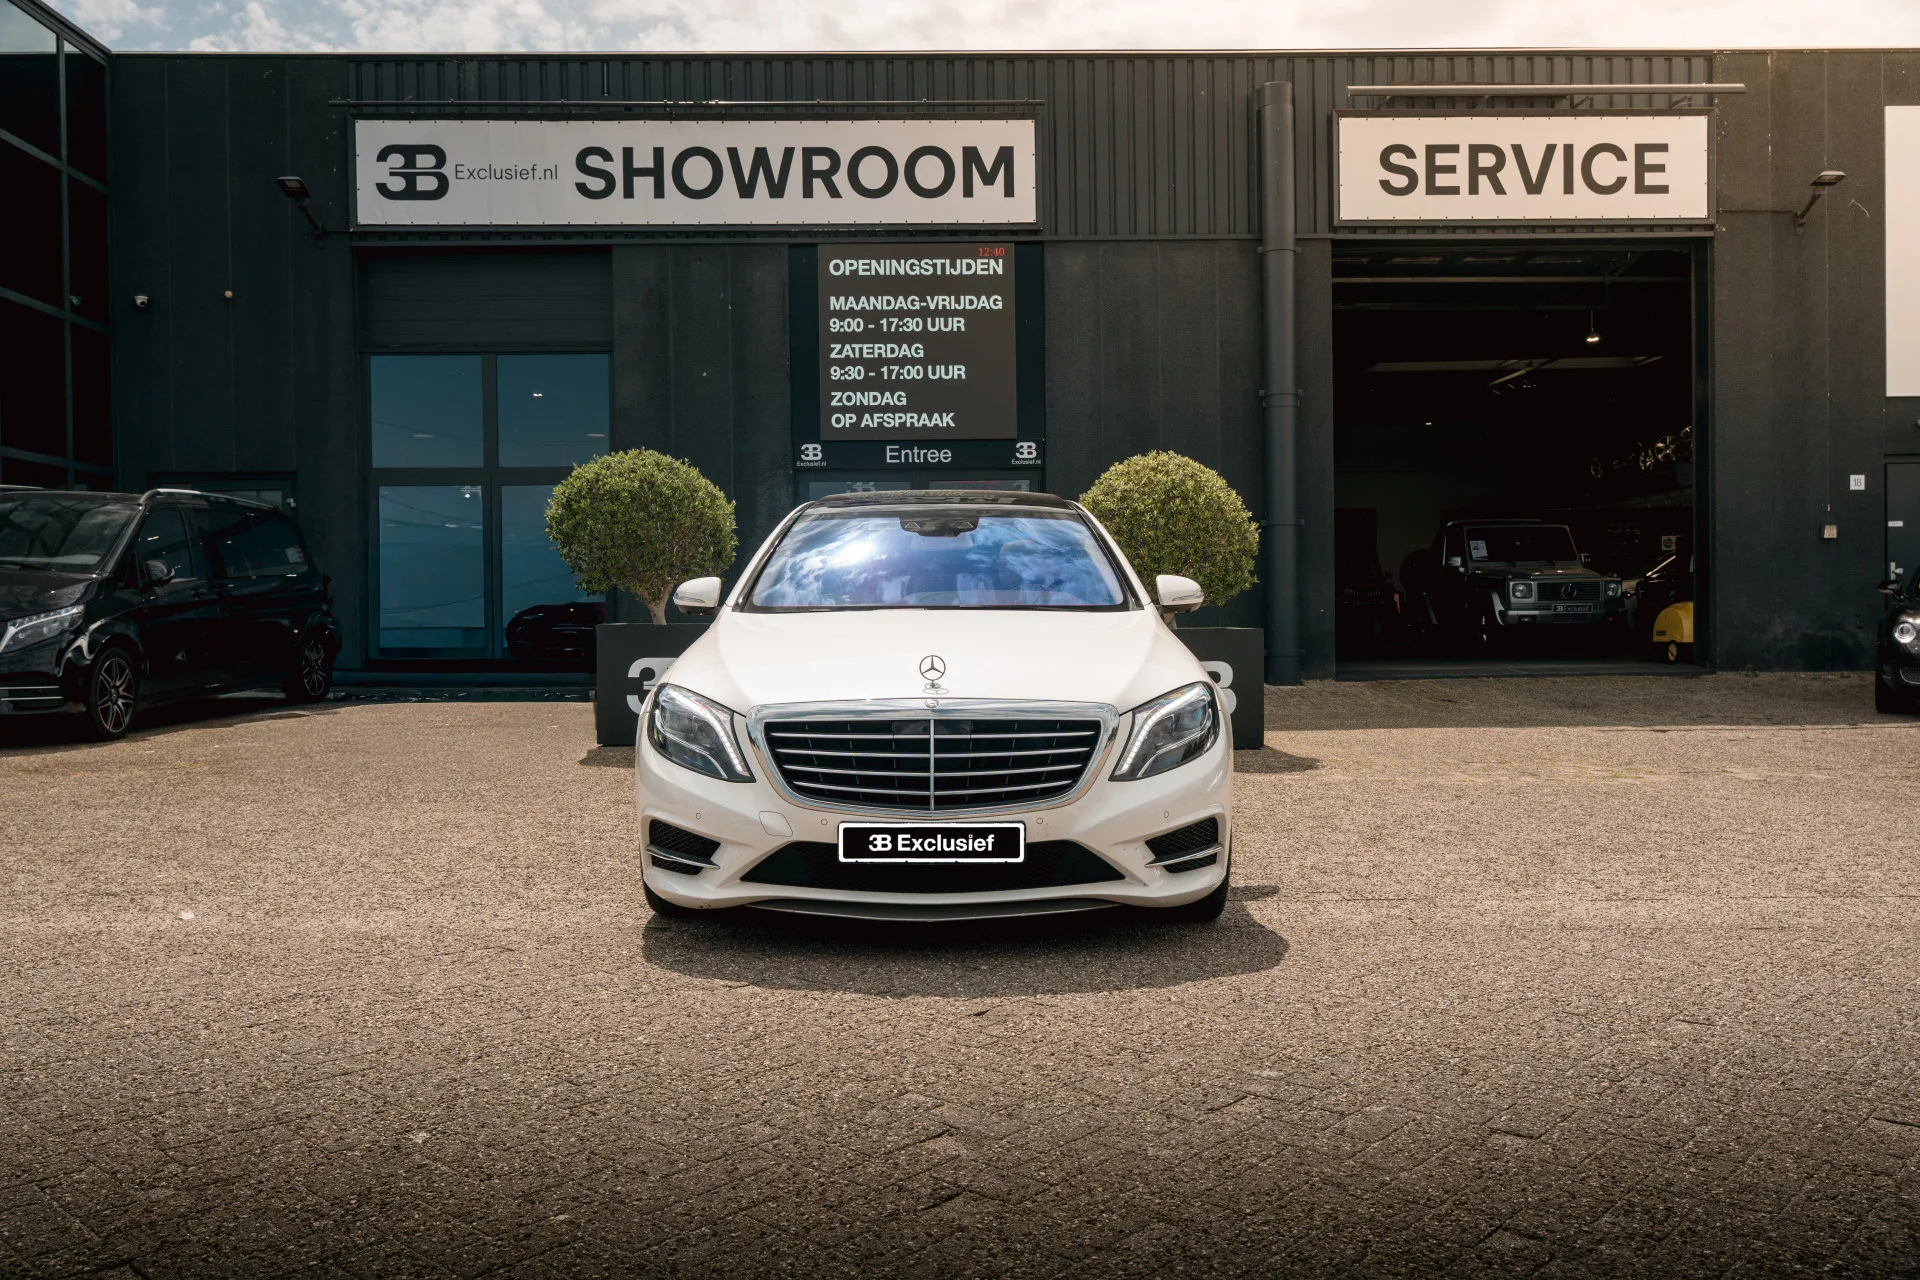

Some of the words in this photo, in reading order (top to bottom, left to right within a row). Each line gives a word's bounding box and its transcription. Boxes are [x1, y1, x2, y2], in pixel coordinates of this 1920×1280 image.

[455, 163, 558, 180] Exclusief.nl
[574, 145, 1015, 200] SHOWROOM
[1378, 143, 1669, 196] SERVICE
[978, 247, 1005, 256] 12:40
[829, 259, 1003, 276] OPENINGSTIJDEN
[829, 295, 1003, 310] MAANDAG-VRIJDAG
[829, 318, 864, 332] 9:00
[880, 318, 923, 332] 17:30
[927, 317, 965, 332] UUR
[830, 344, 924, 358] ZATERDAG
[830, 366, 864, 380] 9:30
[880, 366, 923, 380] 17:00
[927, 365, 966, 380] UUR
[831, 391, 907, 406] ZONDAG
[831, 414, 857, 428] OP
[860, 413, 955, 427] AFSPRAAK
[886, 445, 952, 463] Entree
[1853, 478, 1862, 487] 18
[868, 834, 892, 851] 3B
[897, 834, 995, 851] Exclusief
